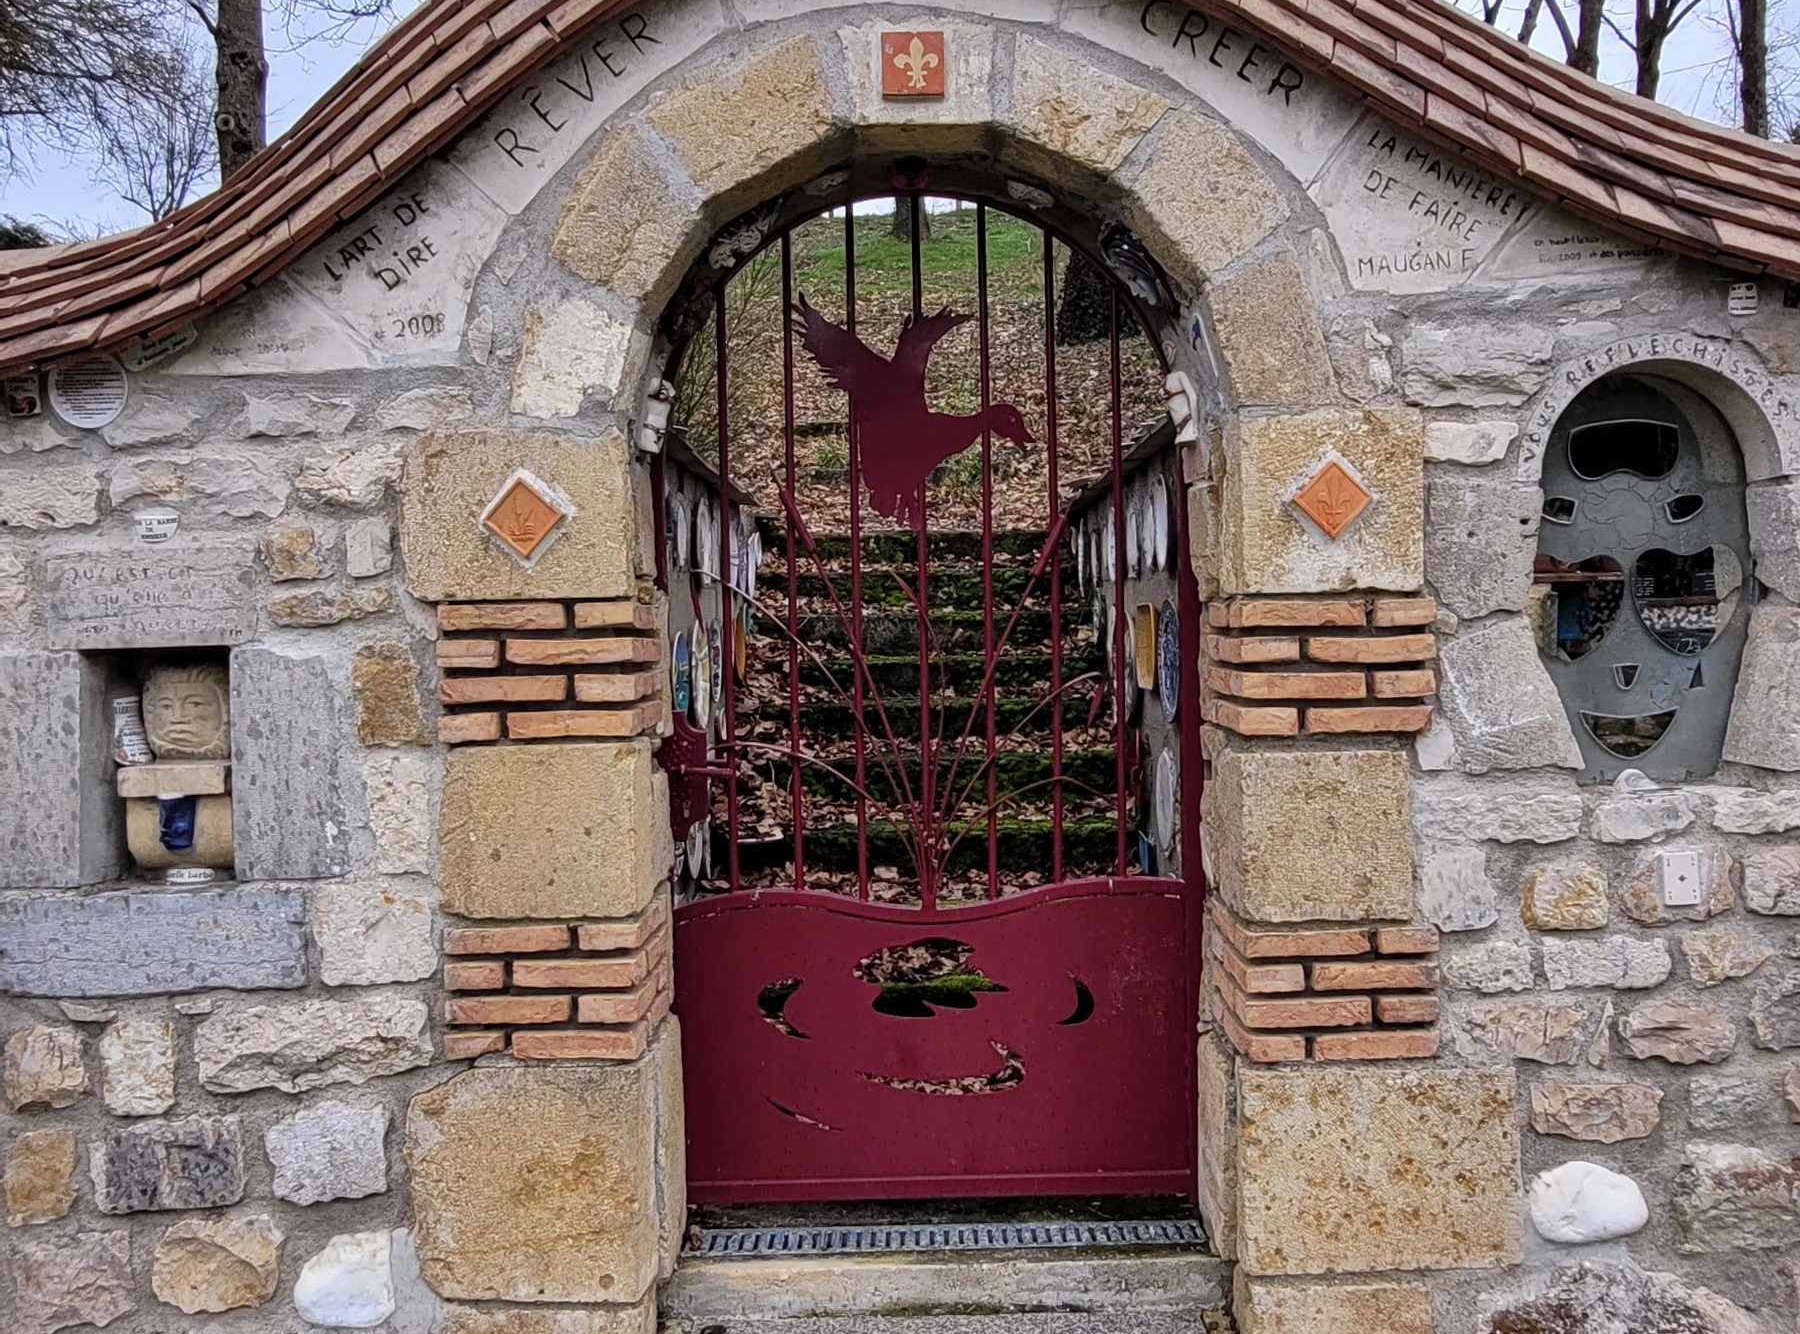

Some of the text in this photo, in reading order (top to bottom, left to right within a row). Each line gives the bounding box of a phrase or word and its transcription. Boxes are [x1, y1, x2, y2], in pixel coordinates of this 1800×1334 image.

[493, 13, 664, 168] RÊVER
[1367, 129, 1397, 157] LA
[1363, 169, 1399, 200] DE
[392, 192, 431, 228] DE
[391, 312, 447, 339] 2008
